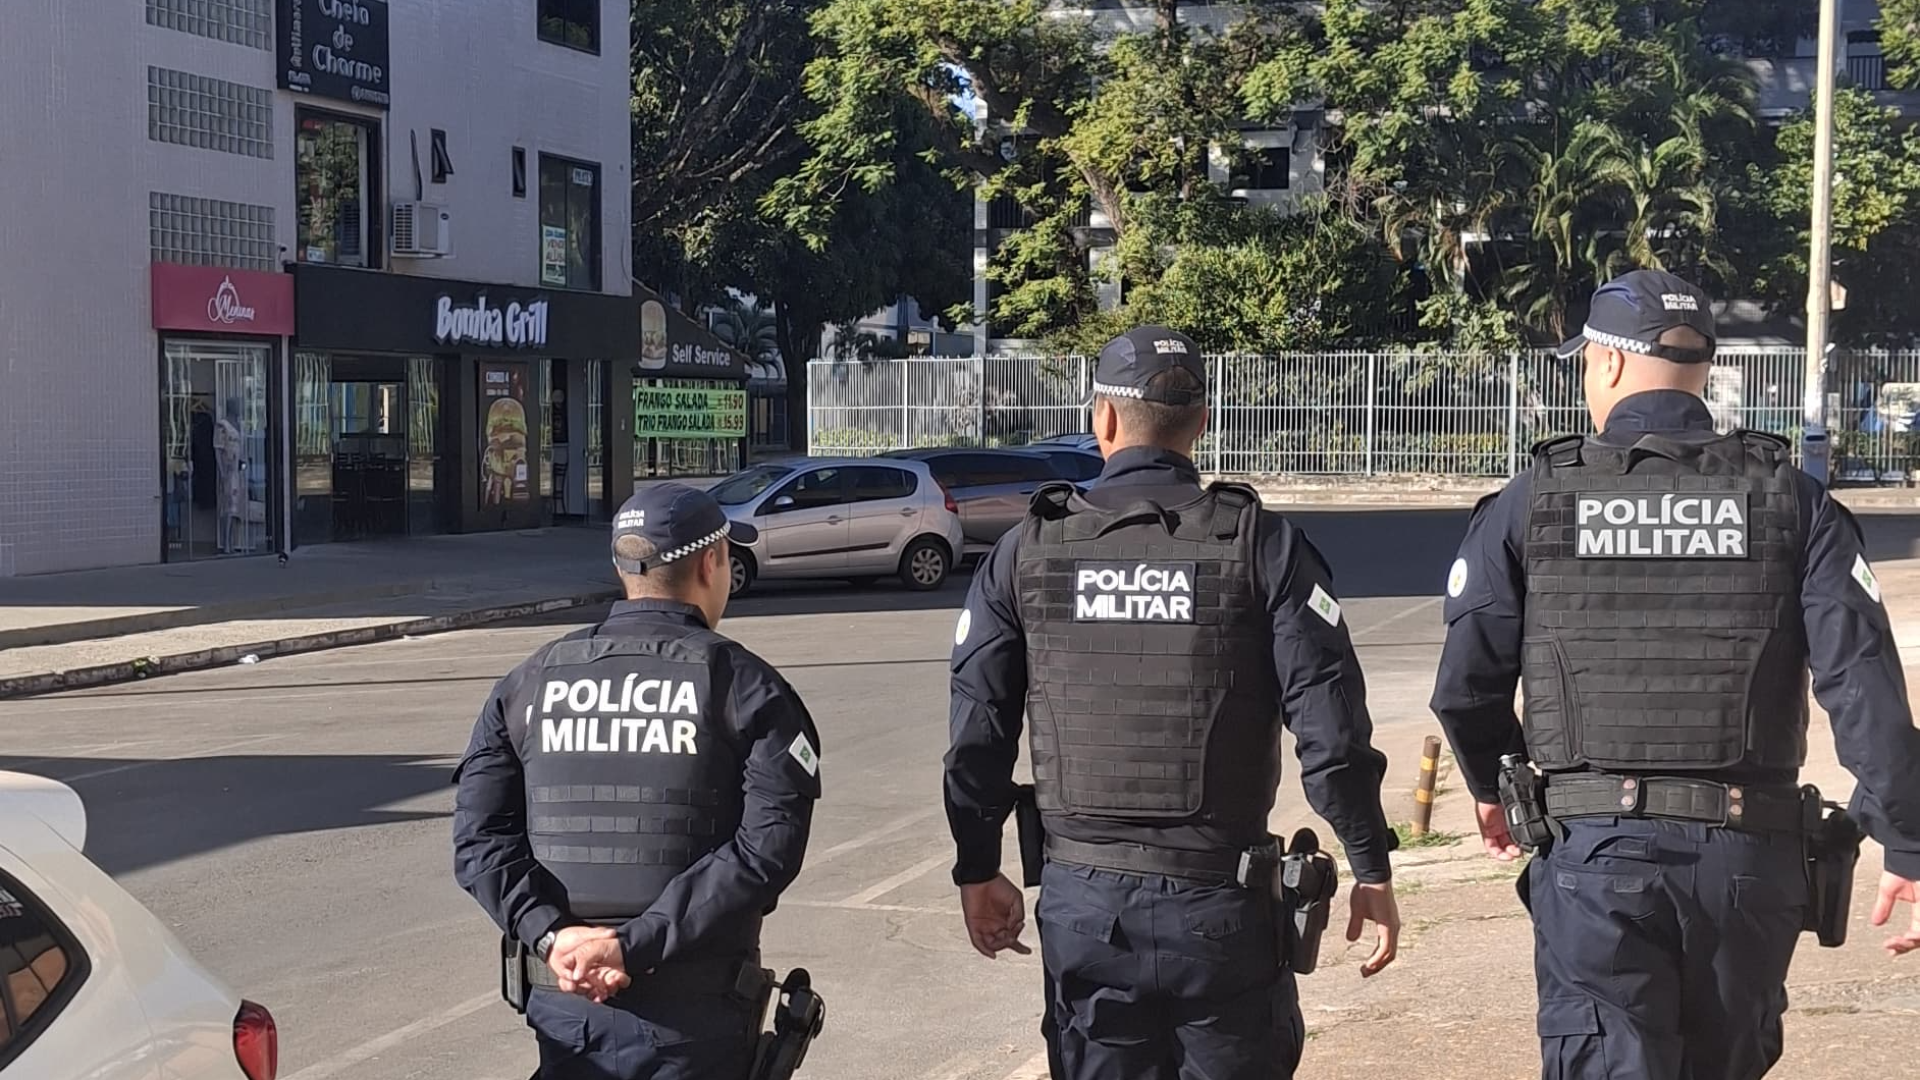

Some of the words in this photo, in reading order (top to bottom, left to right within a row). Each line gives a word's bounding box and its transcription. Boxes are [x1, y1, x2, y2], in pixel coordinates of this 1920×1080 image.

[332, 24, 354, 51] de
[312, 44, 382, 83] Charme
[1661, 293, 1697, 303] POLÍCIA
[1664, 302, 1699, 311] MILITAR
[436, 296, 503, 342] Bomba
[505, 301, 548, 344] Grill
[672, 343, 693, 363] Self
[695, 345, 731, 366] Service
[638, 392, 672, 411] FRANGO
[675, 393, 708, 411] SALADA
[638, 415, 656, 430] TRIO
[657, 415, 687, 431] FRANGO
[688, 415, 715, 431] SALADA
[1577, 494, 1744, 525] POLÍCIA
[1578, 529, 1744, 555] MILITAR
[1076, 564, 1191, 592] POLÍCIA
[1076, 594, 1191, 620] MILITAR
[542, 673, 699, 715] POLÍCIA
[541, 718, 698, 755] MILITAR
